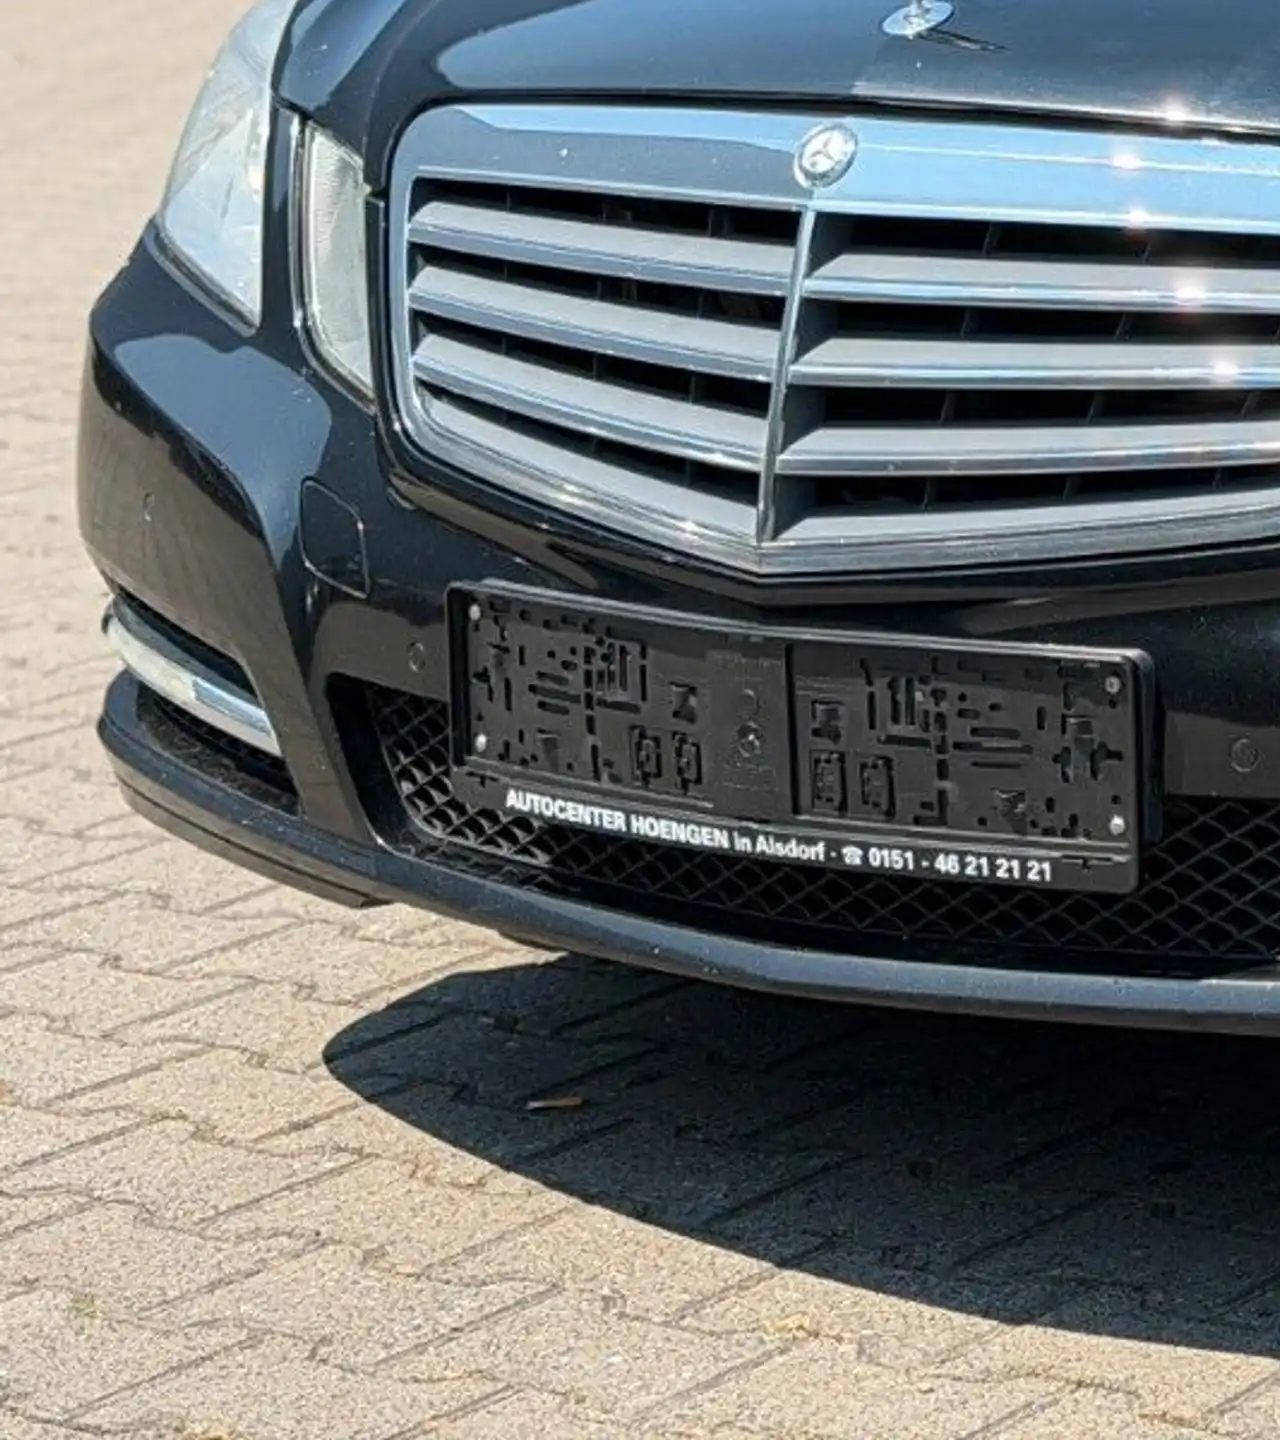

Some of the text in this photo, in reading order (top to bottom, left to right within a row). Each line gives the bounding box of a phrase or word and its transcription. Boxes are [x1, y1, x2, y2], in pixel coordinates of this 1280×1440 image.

[506, 788, 627, 833] AUTOCENTER
[630, 814, 730, 849] HOENGEN
[733, 831, 753, 853] in
[755, 834, 826, 862] Alsdorf
[868, 846, 915, 871] 0151
[934, 852, 960, 875] 46
[964, 854, 990, 877] 21
[994, 857, 1021, 880] 21
[1026, 859, 1051, 882] 21
